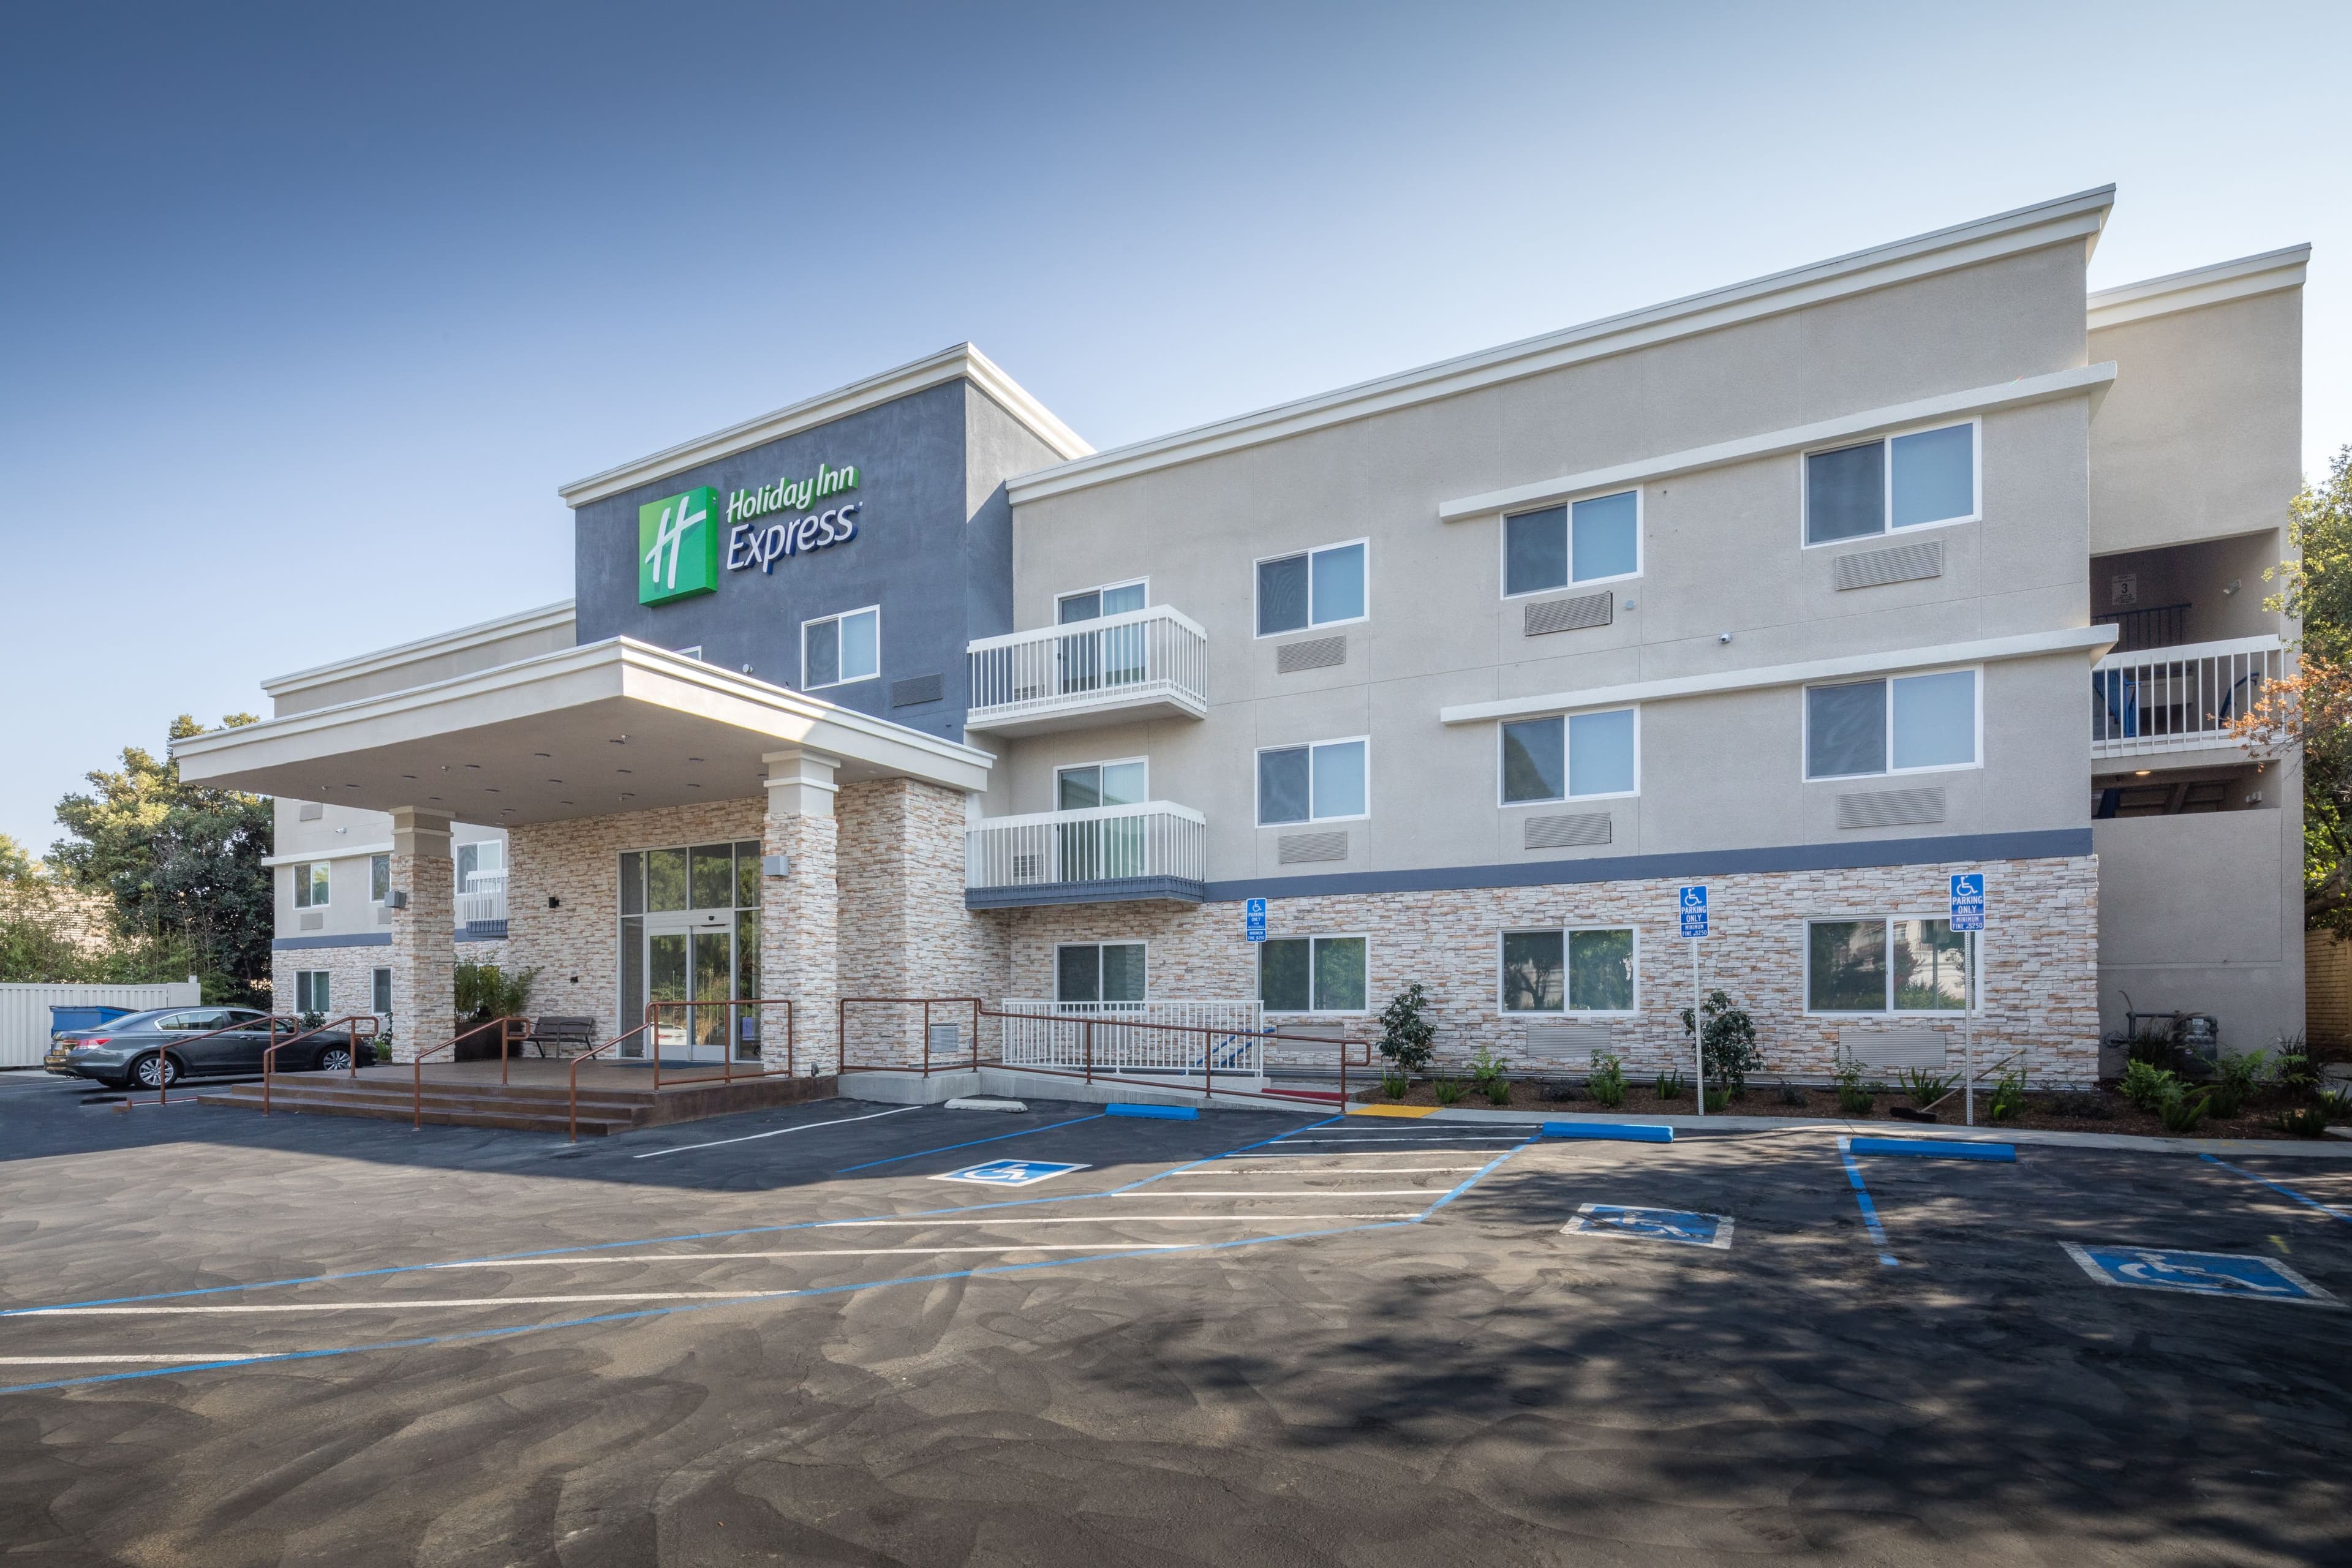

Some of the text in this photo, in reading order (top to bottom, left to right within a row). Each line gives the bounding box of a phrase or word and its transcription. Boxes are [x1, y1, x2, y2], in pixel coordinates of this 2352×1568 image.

[726, 463, 858, 523] Holiday Inn
[726, 505, 858, 575] Express
[2122, 583, 2127, 593] 3
[1953, 896, 1983, 905] PARKING
[1681, 905, 1706, 914] PARKING
